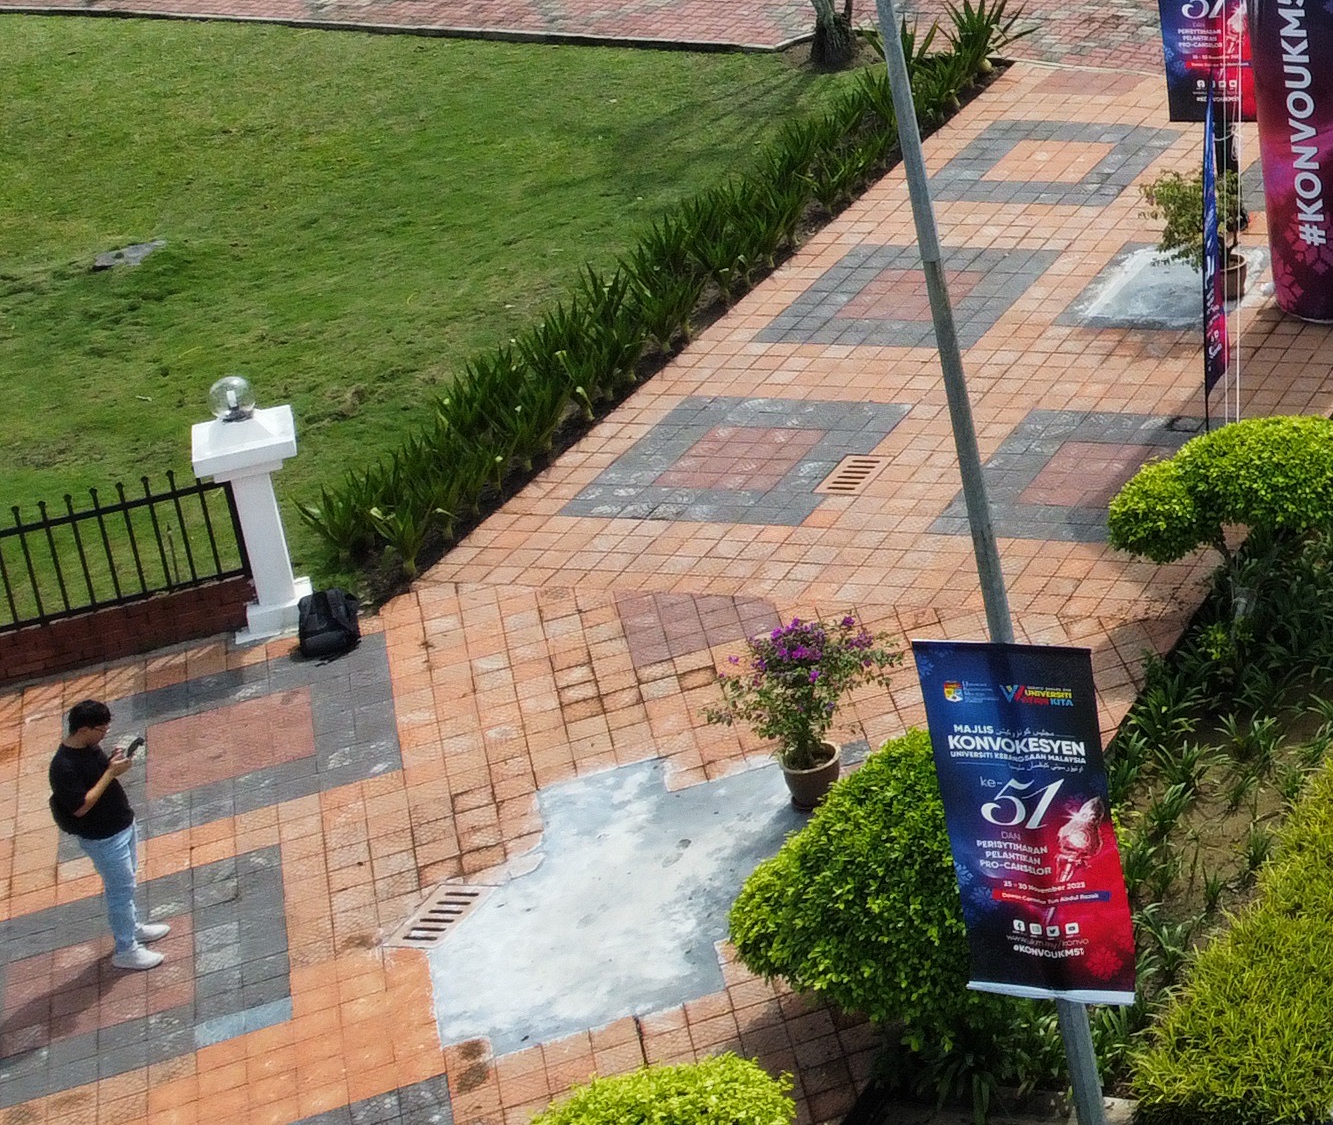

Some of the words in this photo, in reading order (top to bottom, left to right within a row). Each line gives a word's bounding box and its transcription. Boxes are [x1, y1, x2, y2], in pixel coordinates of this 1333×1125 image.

[1024, 690, 1073, 699] UNIVERSITI
[1050, 698, 1074, 707] KITA
[953, 724, 994, 735] MAJLIS
[947, 735, 1086, 757] KONVOKESYEN
[950, 750, 994, 759] UNIVERSITI
[994, 752, 1047, 763] KEBANGSAAN
[1048, 755, 1087, 764] MALAYSIA
[1001, 831, 1021, 841] DAN
[976, 839, 1048, 855] PERISYTIHARAN
[985, 850, 1041, 865] PELANTIKAN
[979, 859, 1052, 876] PRO-CANSELOR
[1028, 884, 1066, 894] November
